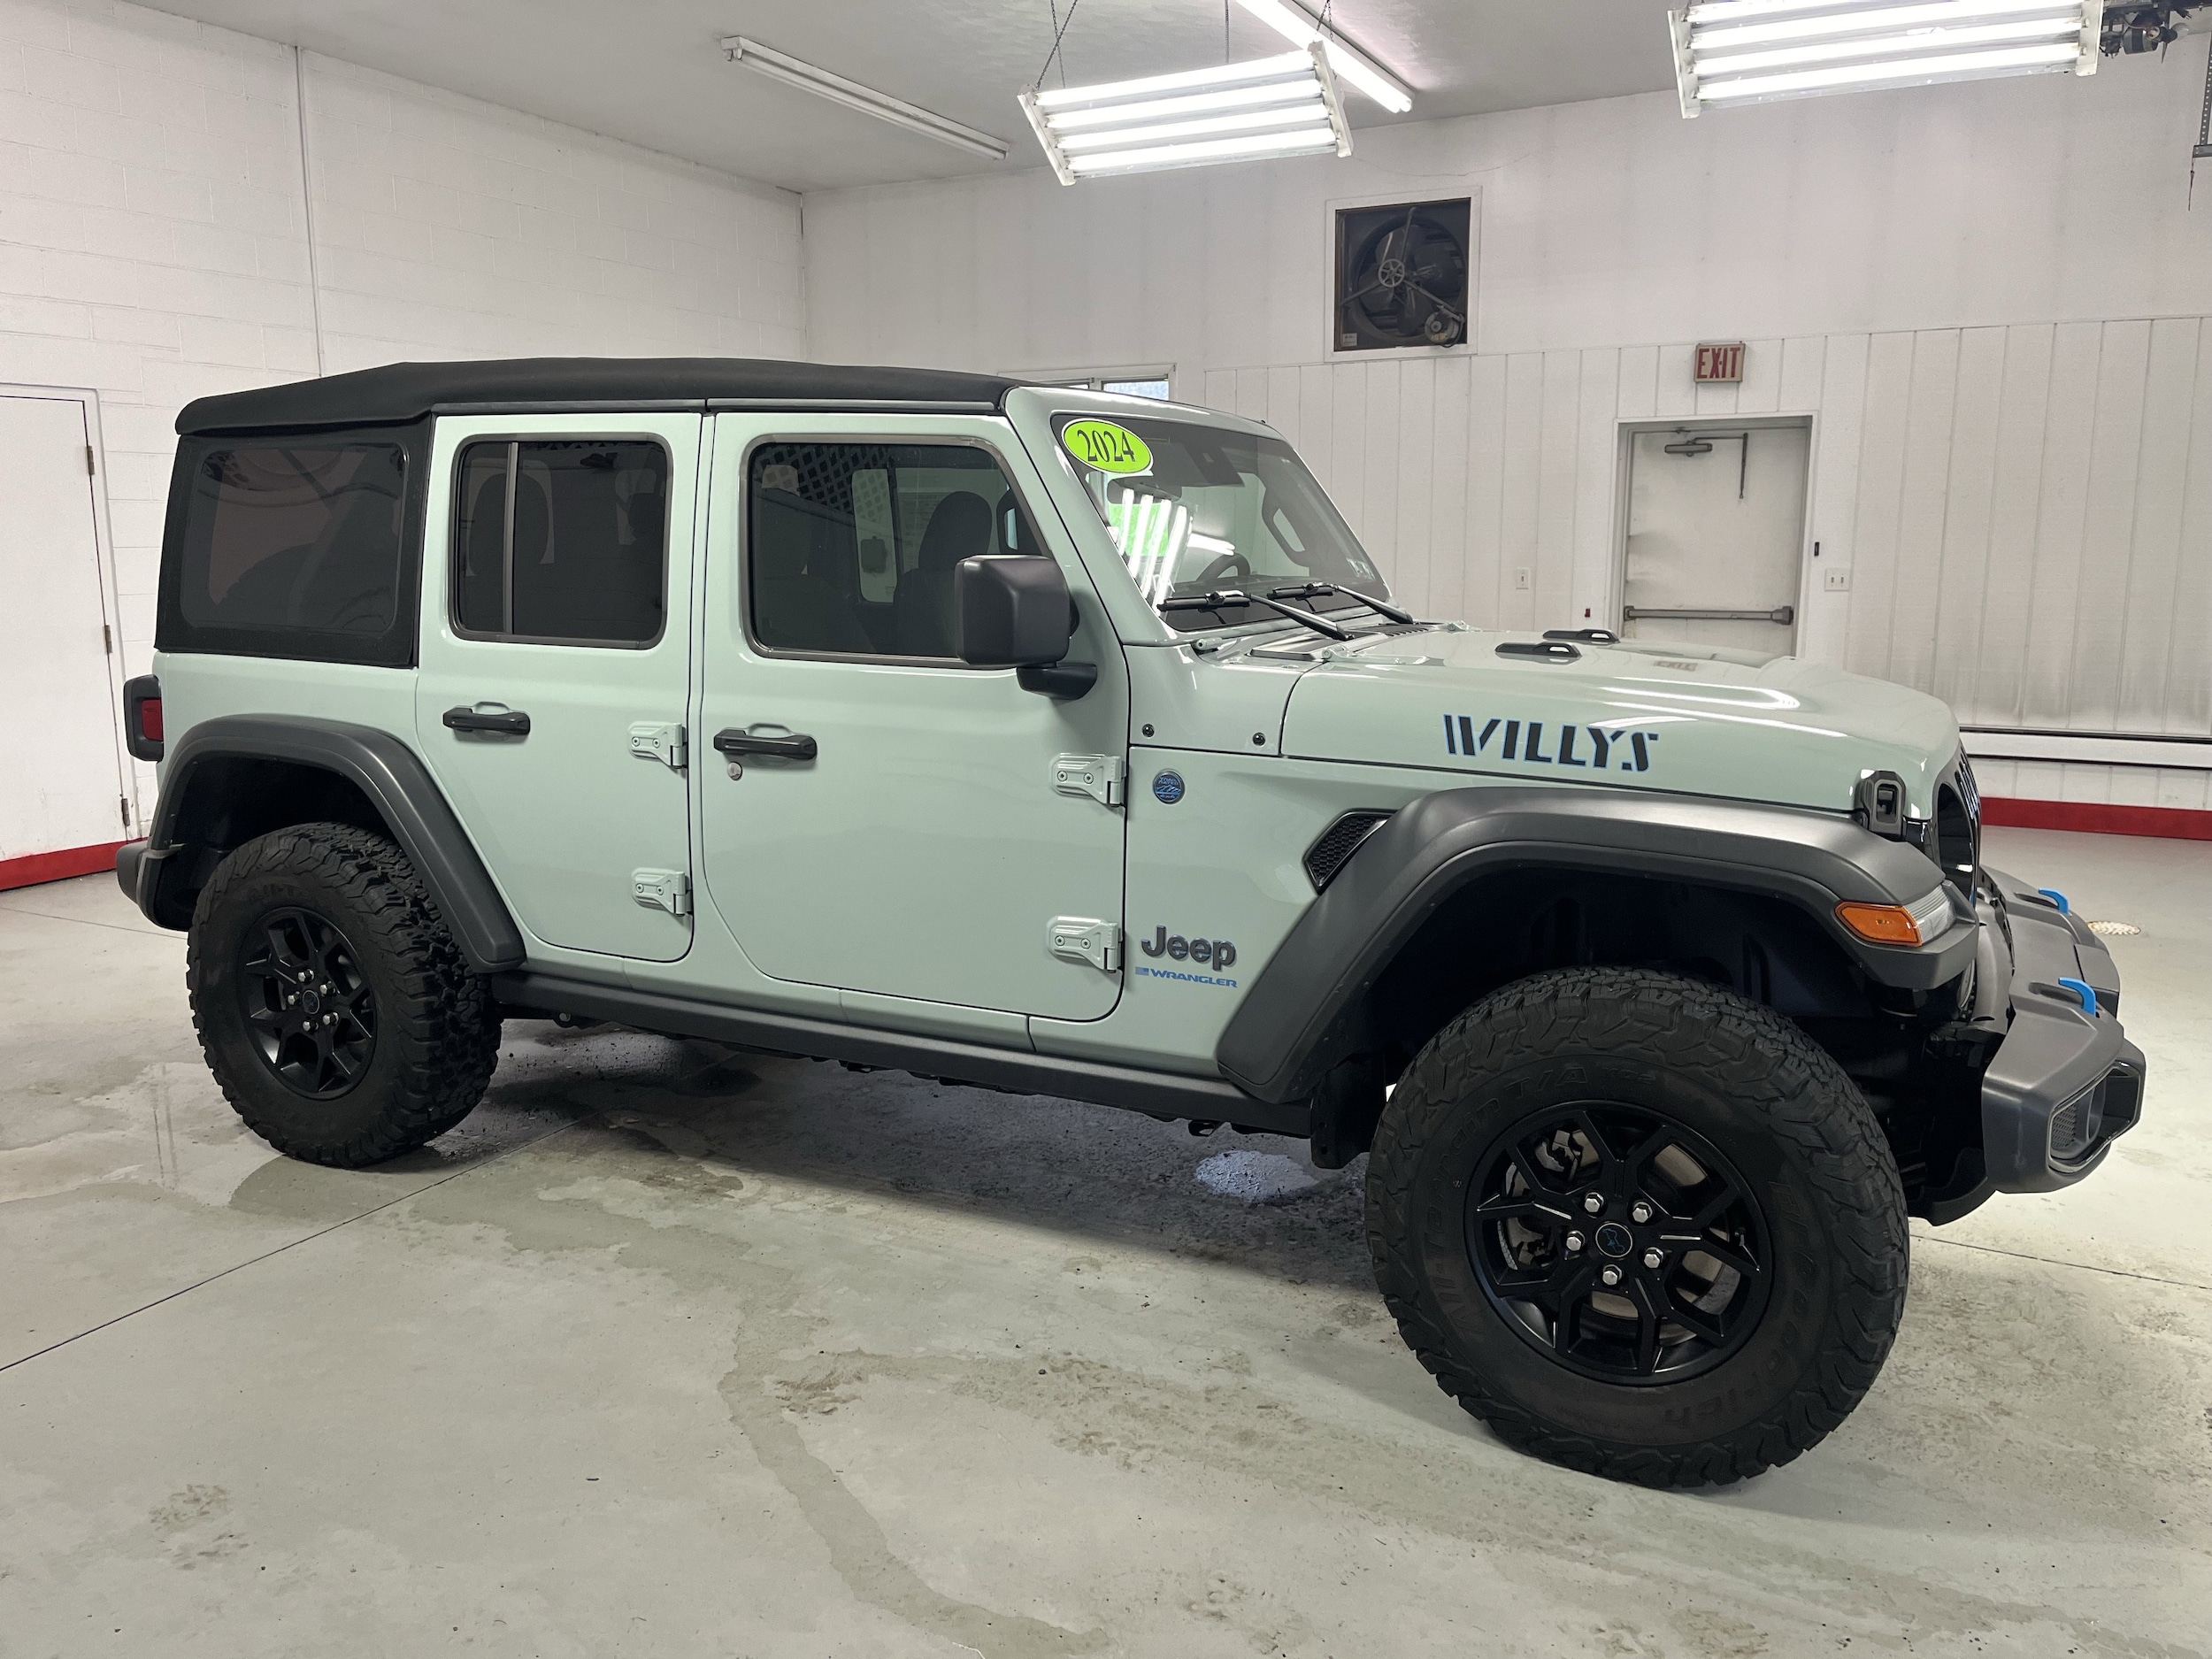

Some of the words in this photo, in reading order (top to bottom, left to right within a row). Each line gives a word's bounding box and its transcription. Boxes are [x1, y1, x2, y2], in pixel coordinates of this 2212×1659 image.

[1696, 347, 1741, 379] EXIT
[1077, 429, 1136, 463] 2024
[1442, 713, 1660, 773] WILLYS
[1141, 925, 1237, 972] Jeep
[1150, 968, 1238, 987] WRANGLER
[1503, 1066, 1588, 1100] T/A
